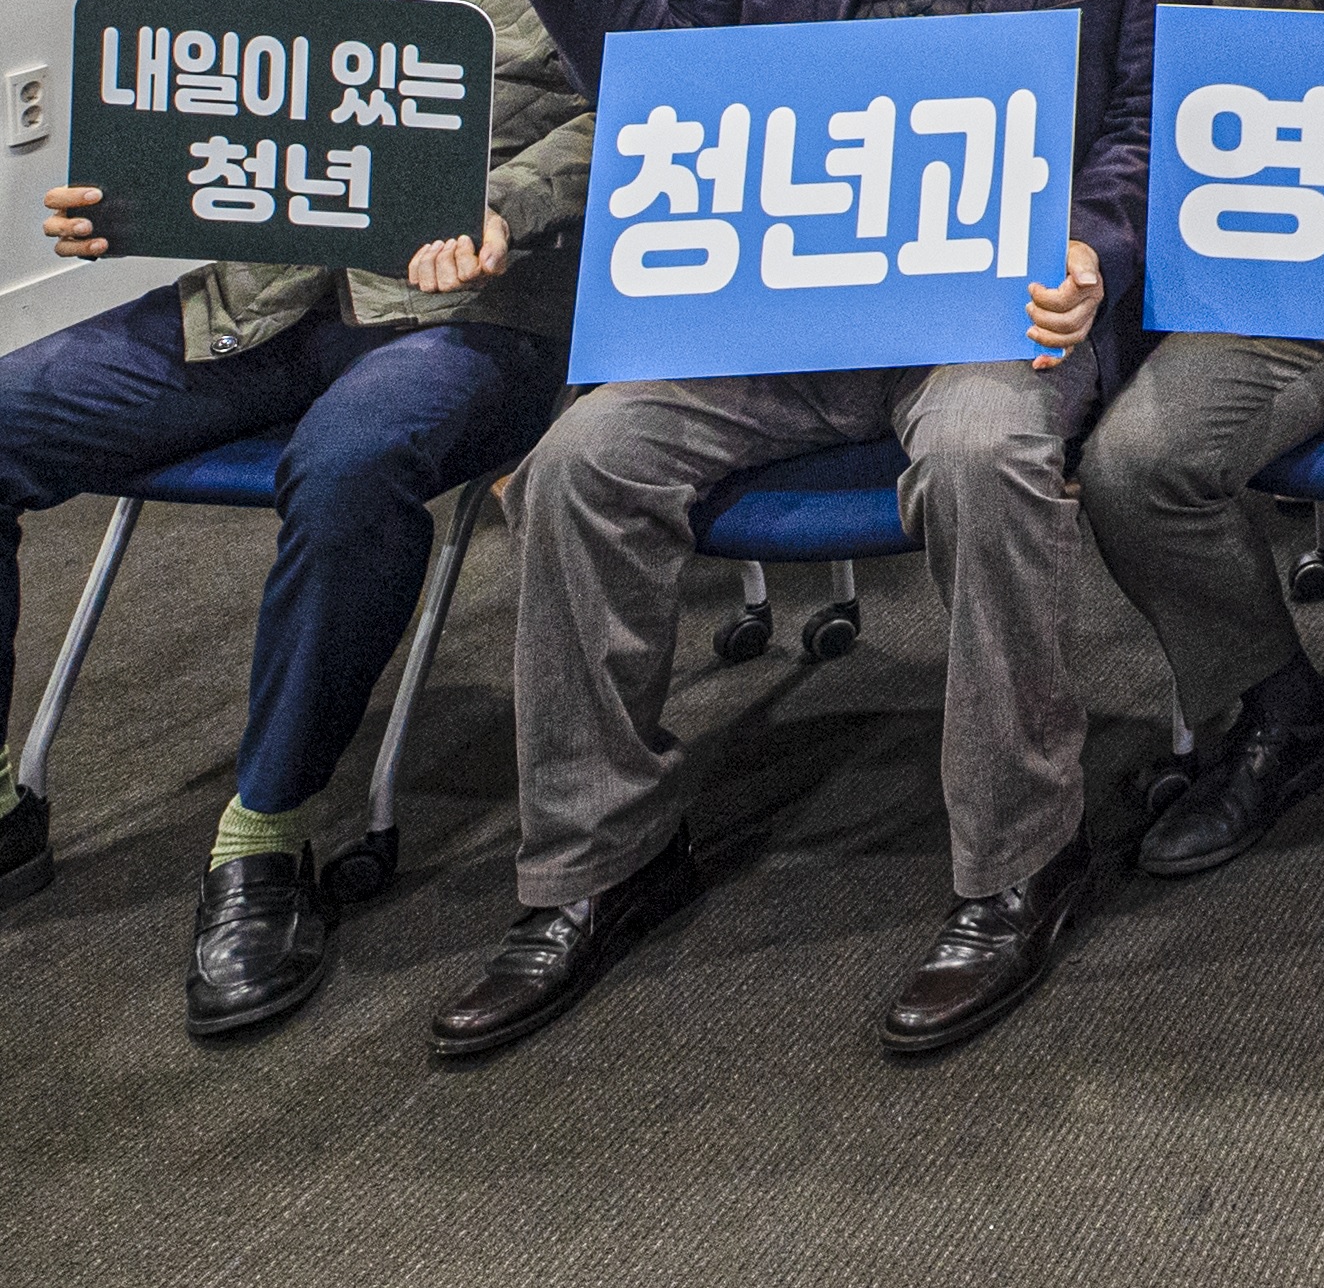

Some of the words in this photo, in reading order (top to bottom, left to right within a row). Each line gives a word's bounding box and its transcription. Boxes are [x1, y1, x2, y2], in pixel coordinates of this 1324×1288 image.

[101, 25, 309, 121] 내일이
[331, 40, 465, 130] 있는
[188, 135, 372, 229] 청년
[608, 89, 1049, 297] 청년과
